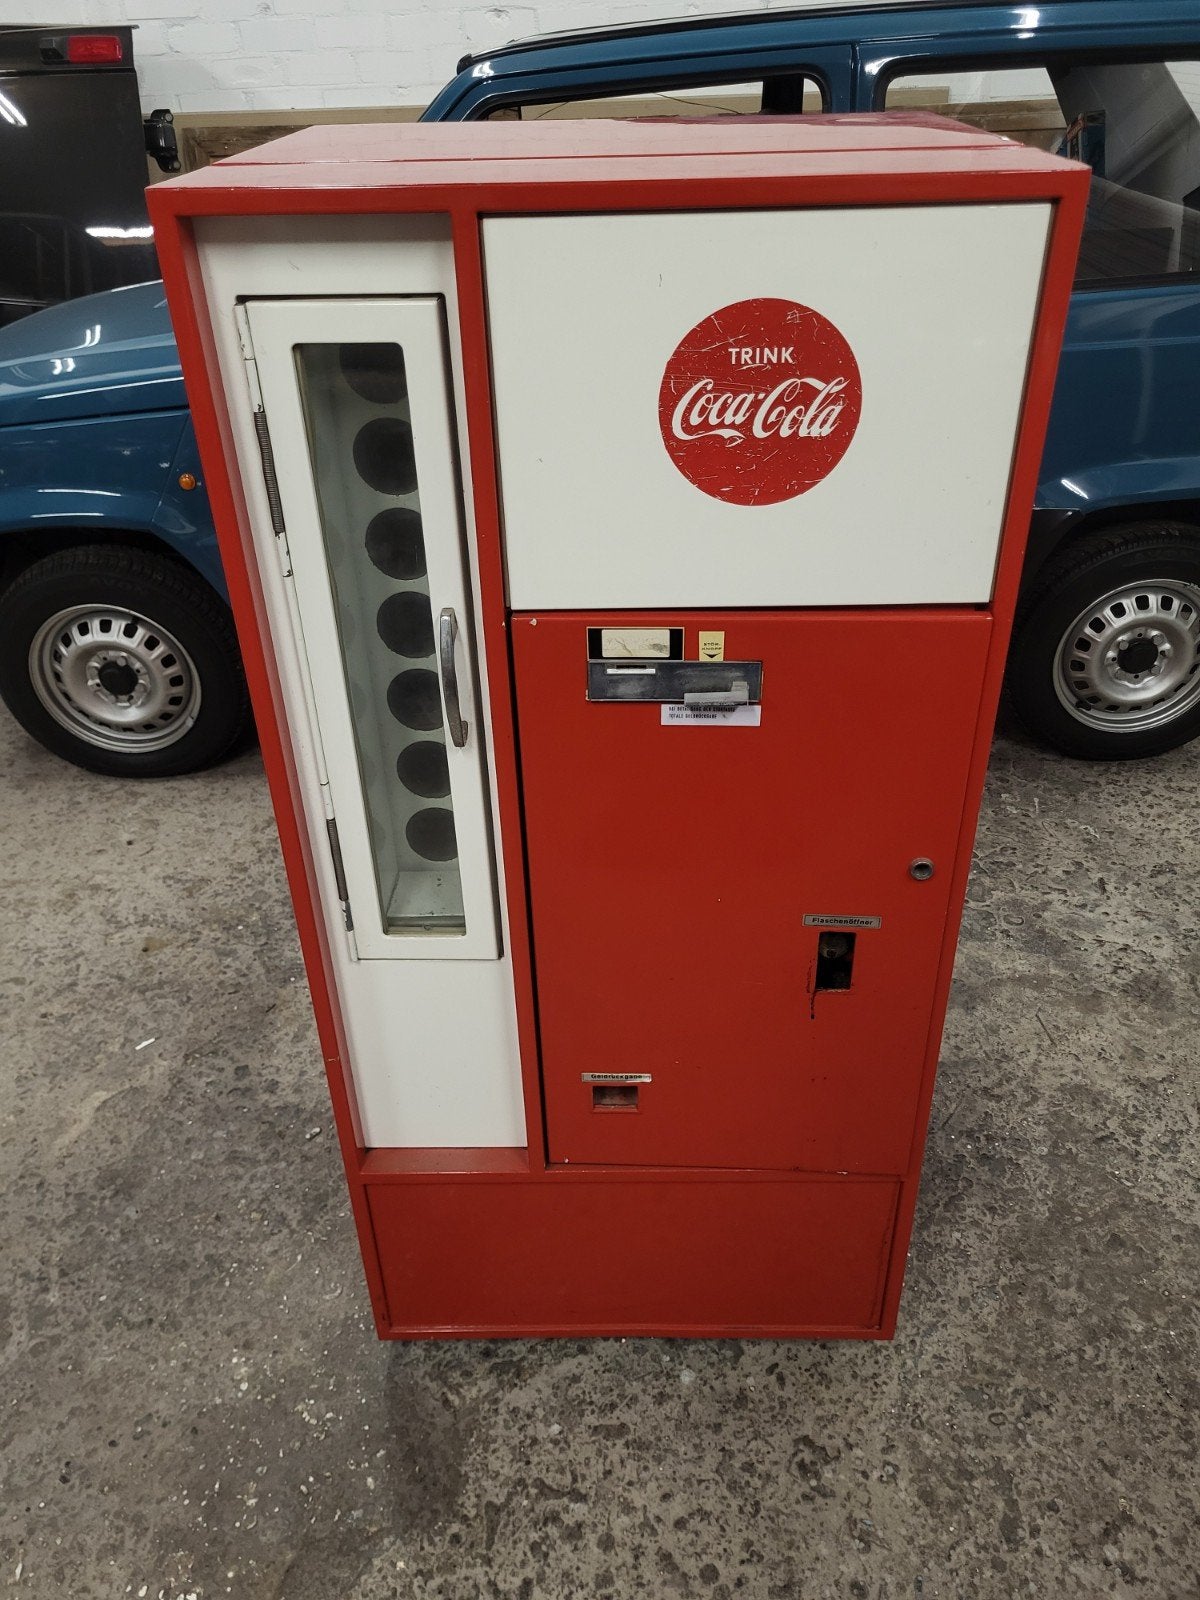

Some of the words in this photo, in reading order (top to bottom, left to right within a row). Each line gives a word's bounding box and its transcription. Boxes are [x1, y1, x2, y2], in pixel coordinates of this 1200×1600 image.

[728, 347, 794, 365] TRINK
[672, 377, 850, 447] Coca-Cola
[812, 917, 874, 926] Flaschenöffner
